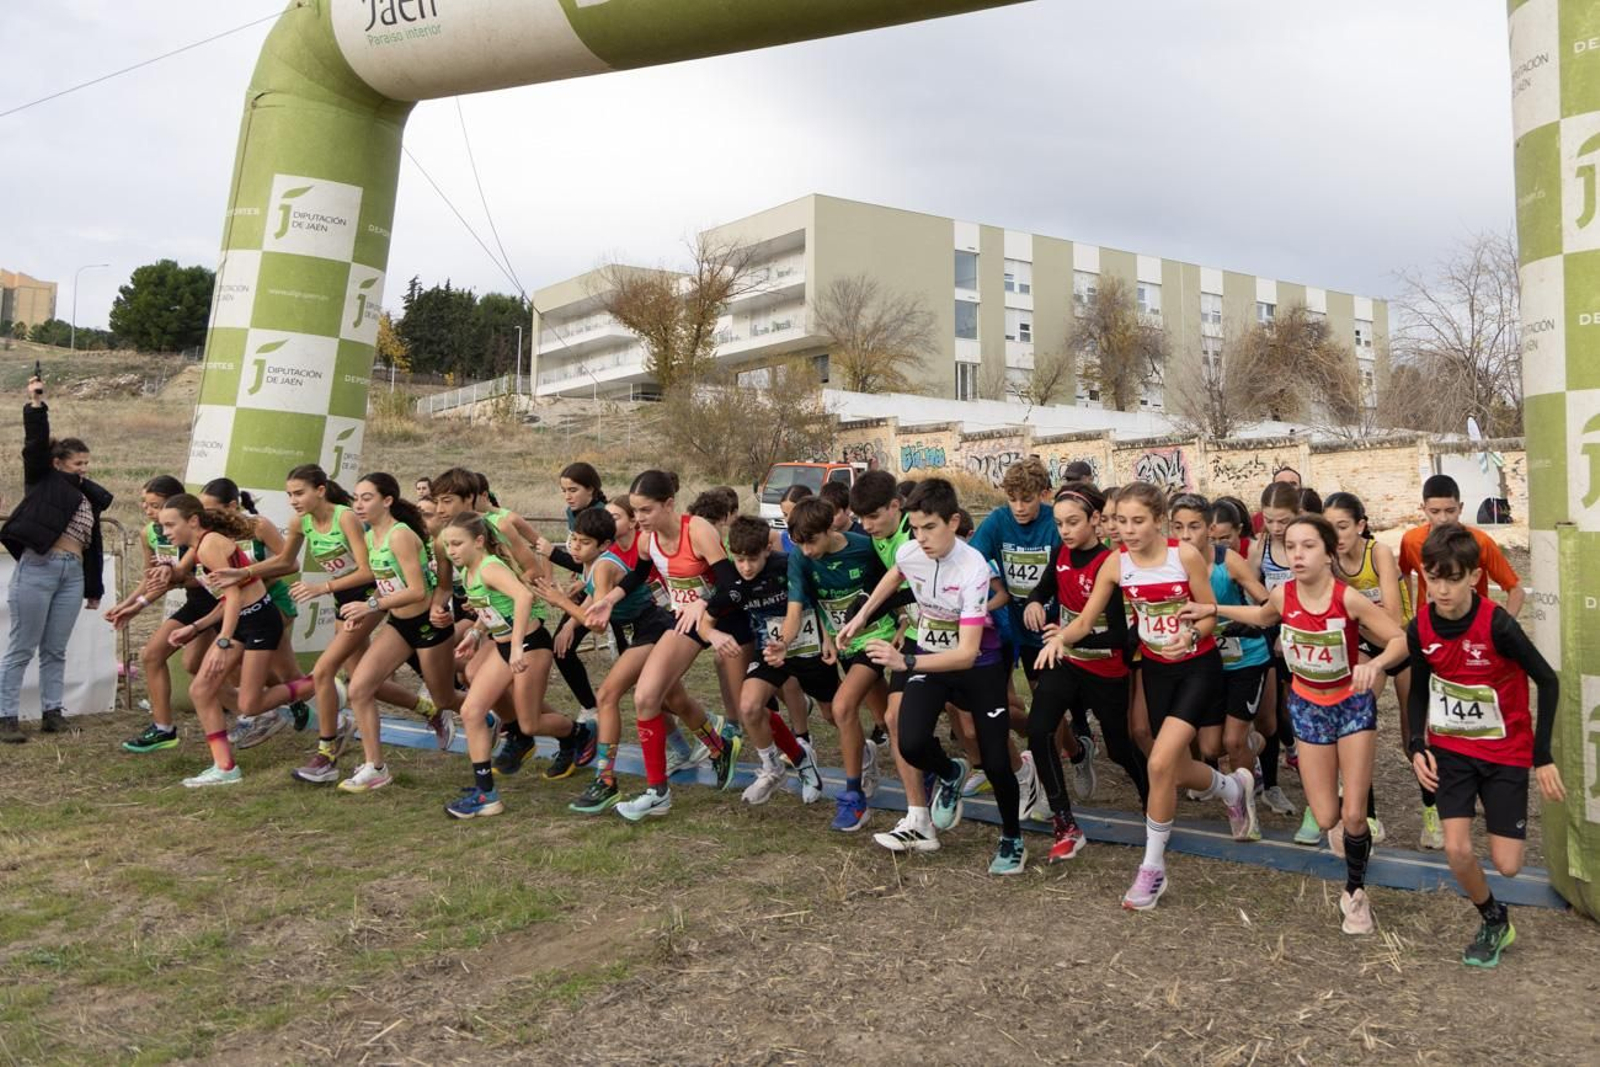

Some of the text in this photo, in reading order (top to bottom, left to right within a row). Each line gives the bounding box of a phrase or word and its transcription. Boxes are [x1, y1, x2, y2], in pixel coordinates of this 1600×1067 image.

[291, 220, 328, 232] DE JAÉN
[292, 211, 347, 227] DIPUTACIÓN
[267, 366, 323, 380] DIPUTACIÓN
[266, 376, 304, 387] DE JAÉN
[323, 557, 345, 573] 30
[1008, 564, 1038, 580] 442
[378, 580, 395, 594] 13
[671, 589, 699, 604] 228
[743, 599, 761, 610] SAN
[1144, 615, 1180, 634] 149
[925, 630, 959, 646] 441
[1289, 644, 1334, 664] 174
[1440, 695, 1484, 720] 144
